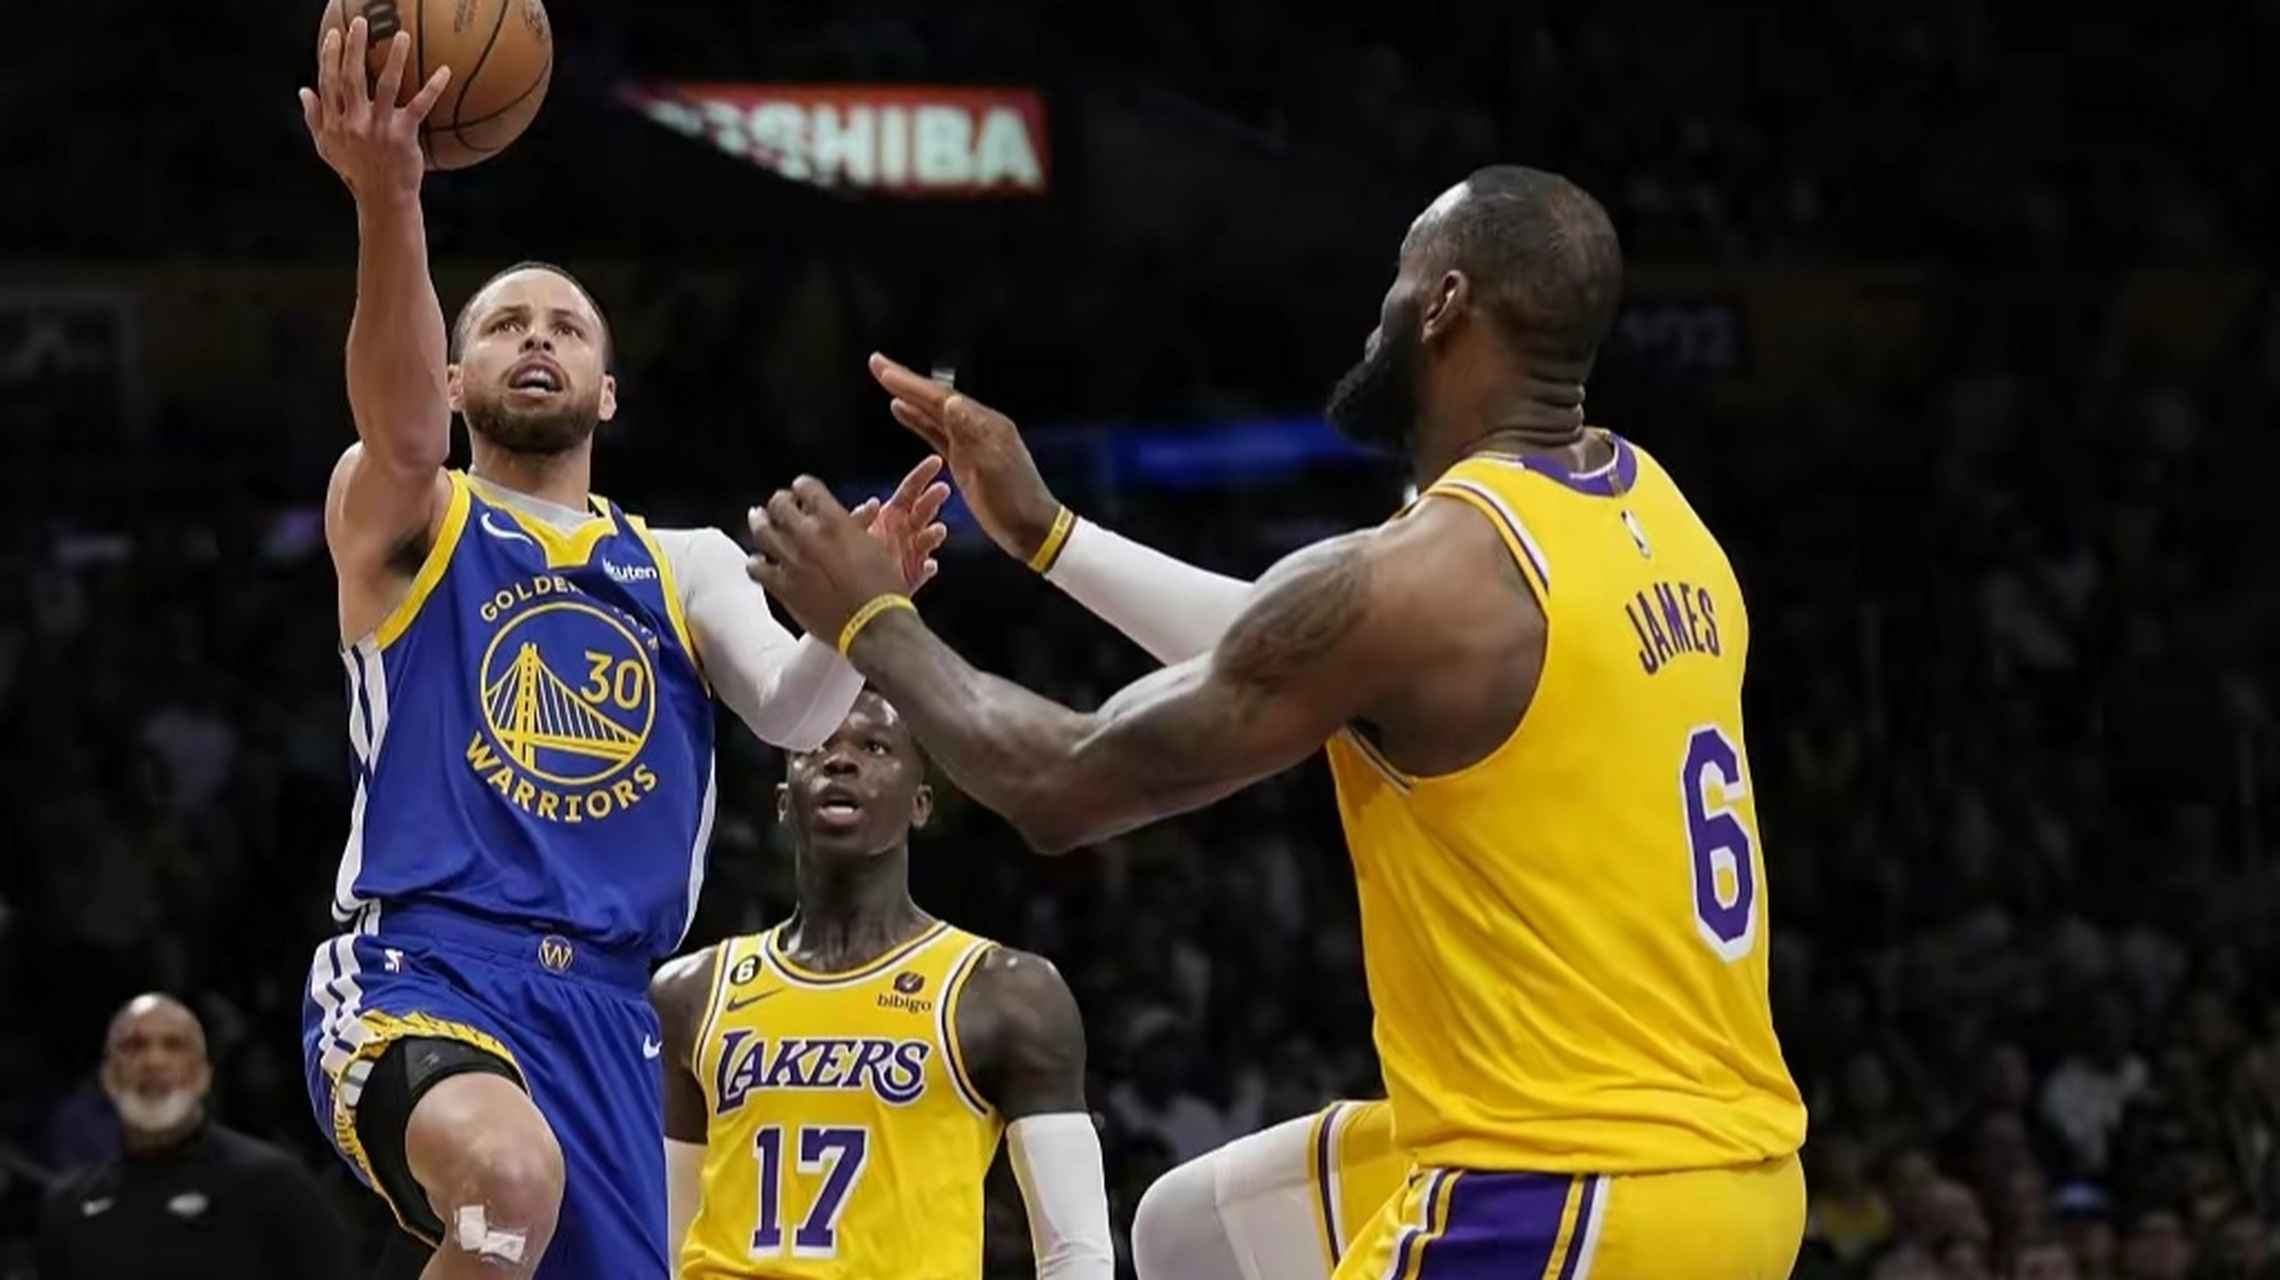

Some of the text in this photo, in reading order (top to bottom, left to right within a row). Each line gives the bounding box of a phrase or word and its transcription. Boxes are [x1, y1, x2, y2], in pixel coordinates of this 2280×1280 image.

[1626, 582, 1720, 674] JAMES
[580, 650, 646, 711] 30
[466, 731, 657, 822] WARRIORS
[1681, 722, 1755, 964] 6
[541, 943, 573, 970] W
[735, 958, 757, 983] 6
[876, 992, 933, 1014] bibigo
[715, 1028, 932, 1116] LAKERS
[750, 1124, 869, 1259] 17
